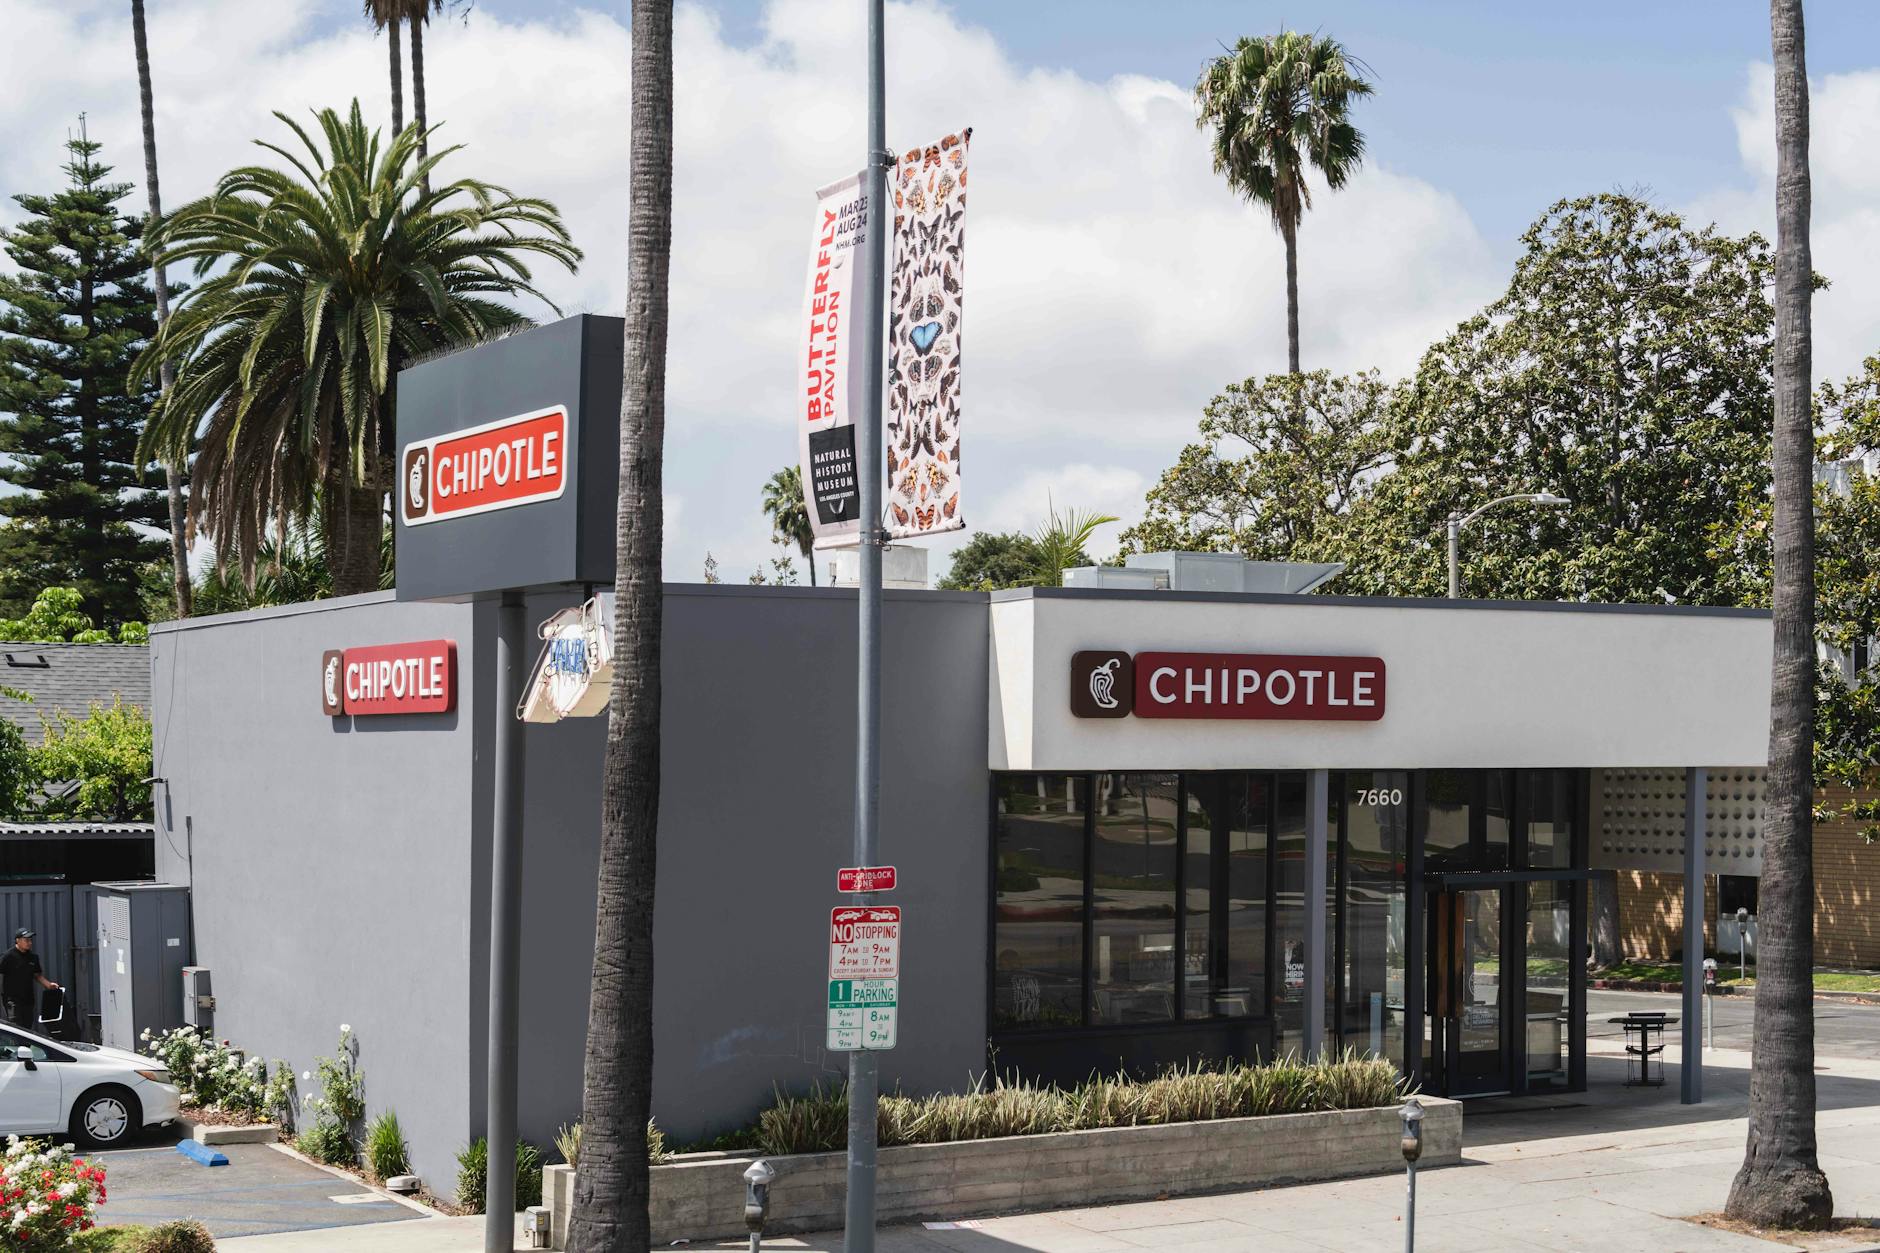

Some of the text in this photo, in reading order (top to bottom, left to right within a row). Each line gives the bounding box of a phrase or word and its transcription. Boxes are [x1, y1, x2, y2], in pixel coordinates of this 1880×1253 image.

[839, 200, 858, 219] MAR
[837, 212, 868, 237] AUG 24
[836, 233, 866, 250] NHM.ORG
[807, 209, 837, 421] BUTTERFLY
[824, 291, 840, 416] PAVILION
[436, 430, 559, 498] CHIPOTLE
[814, 448, 850, 464] NATURAL
[816, 462, 852, 478] HISTORY
[817, 477, 853, 492] MUSEUM
[346, 656, 443, 700] CHIPOTLE
[1149, 666, 1376, 706] CHIPOTLE
[1356, 788, 1402, 806] 7660
[853, 879, 873, 888] ZONE
[832, 923, 853, 942] NO
[855, 925, 897, 939] STOPPING
[1286, 963, 1304, 971] NOW
[1286, 970, 1304, 978] HIRIN
[837, 982, 844, 1001] 1
[853, 988, 894, 1002] PARKING
